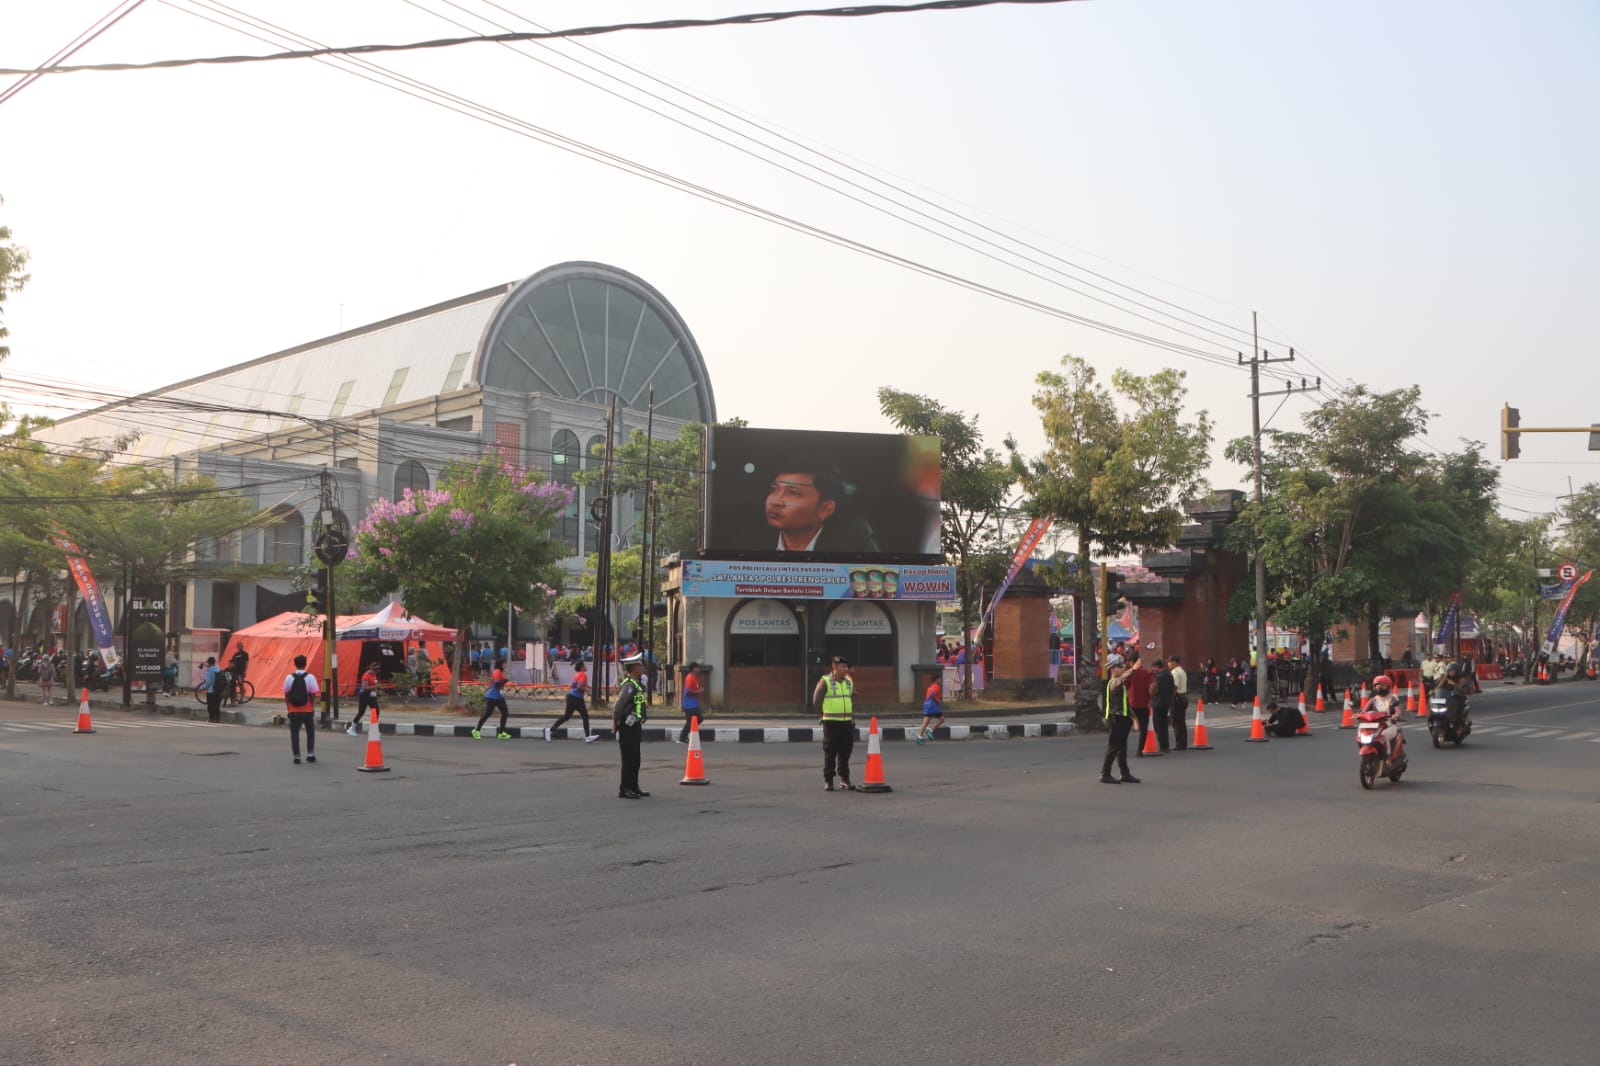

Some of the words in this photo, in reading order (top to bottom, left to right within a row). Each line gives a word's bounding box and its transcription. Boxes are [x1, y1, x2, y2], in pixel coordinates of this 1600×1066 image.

[711, 574, 760, 582] SATLANTAS
[761, 575, 792, 583] POLRES
[793, 576, 847, 584] TRENGGALEK
[903, 581, 951, 592] WOWIN
